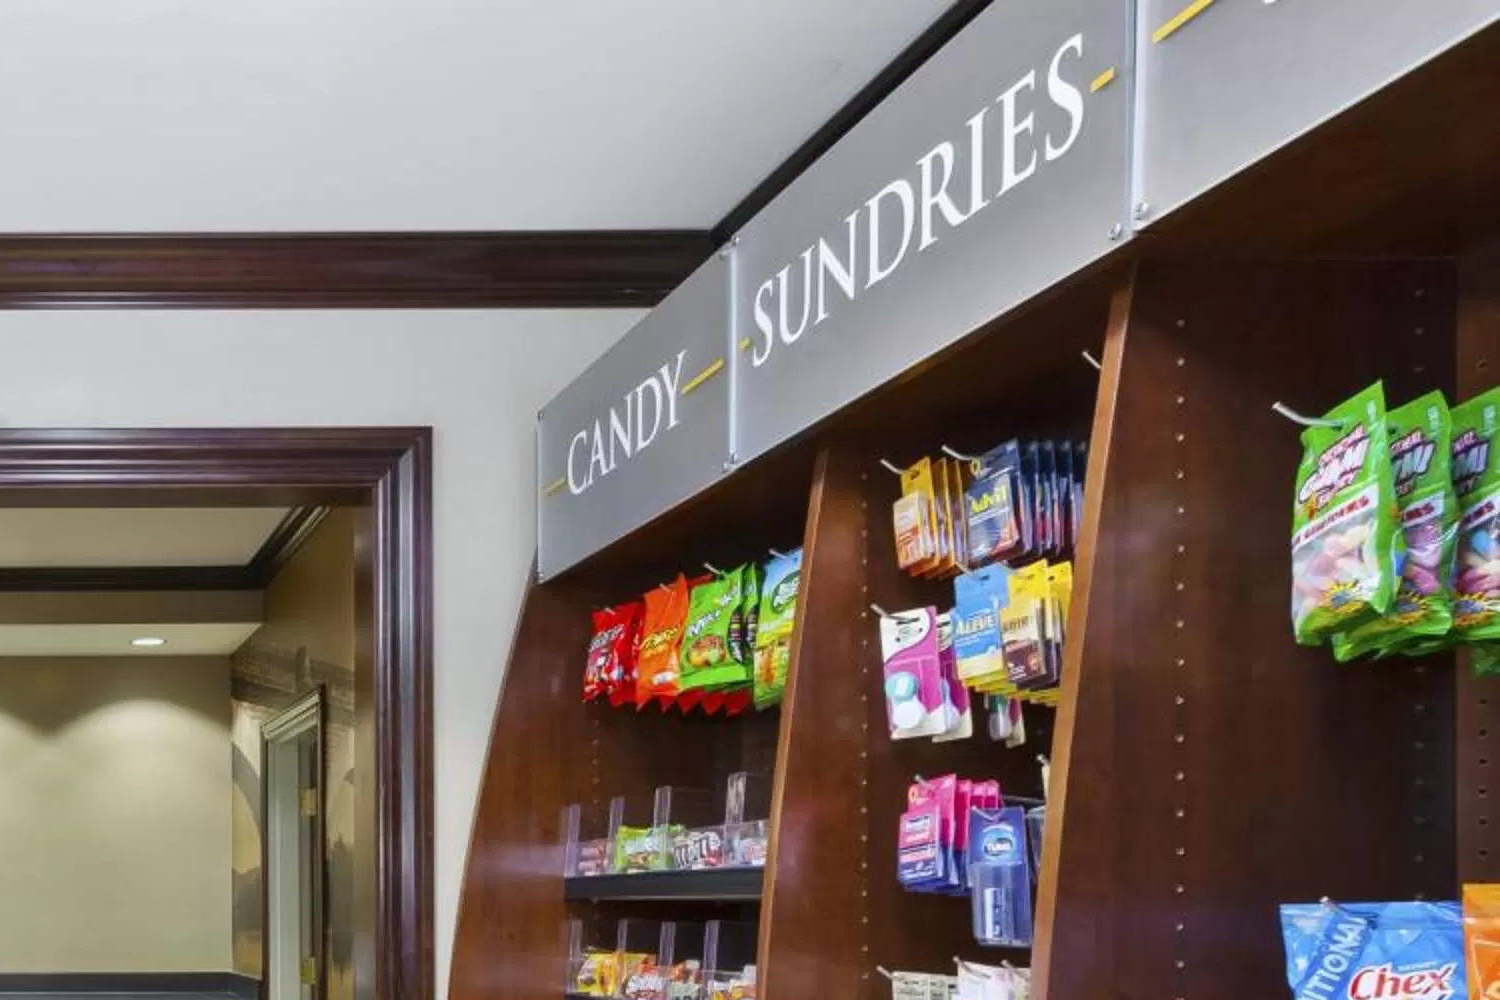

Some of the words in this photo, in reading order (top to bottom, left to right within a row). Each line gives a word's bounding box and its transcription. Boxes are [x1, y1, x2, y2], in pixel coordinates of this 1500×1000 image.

[750, 32, 1086, 367] SUNDRIES
[566, 352, 688, 496] CANDY
[1350, 963, 1454, 1000] Chex
